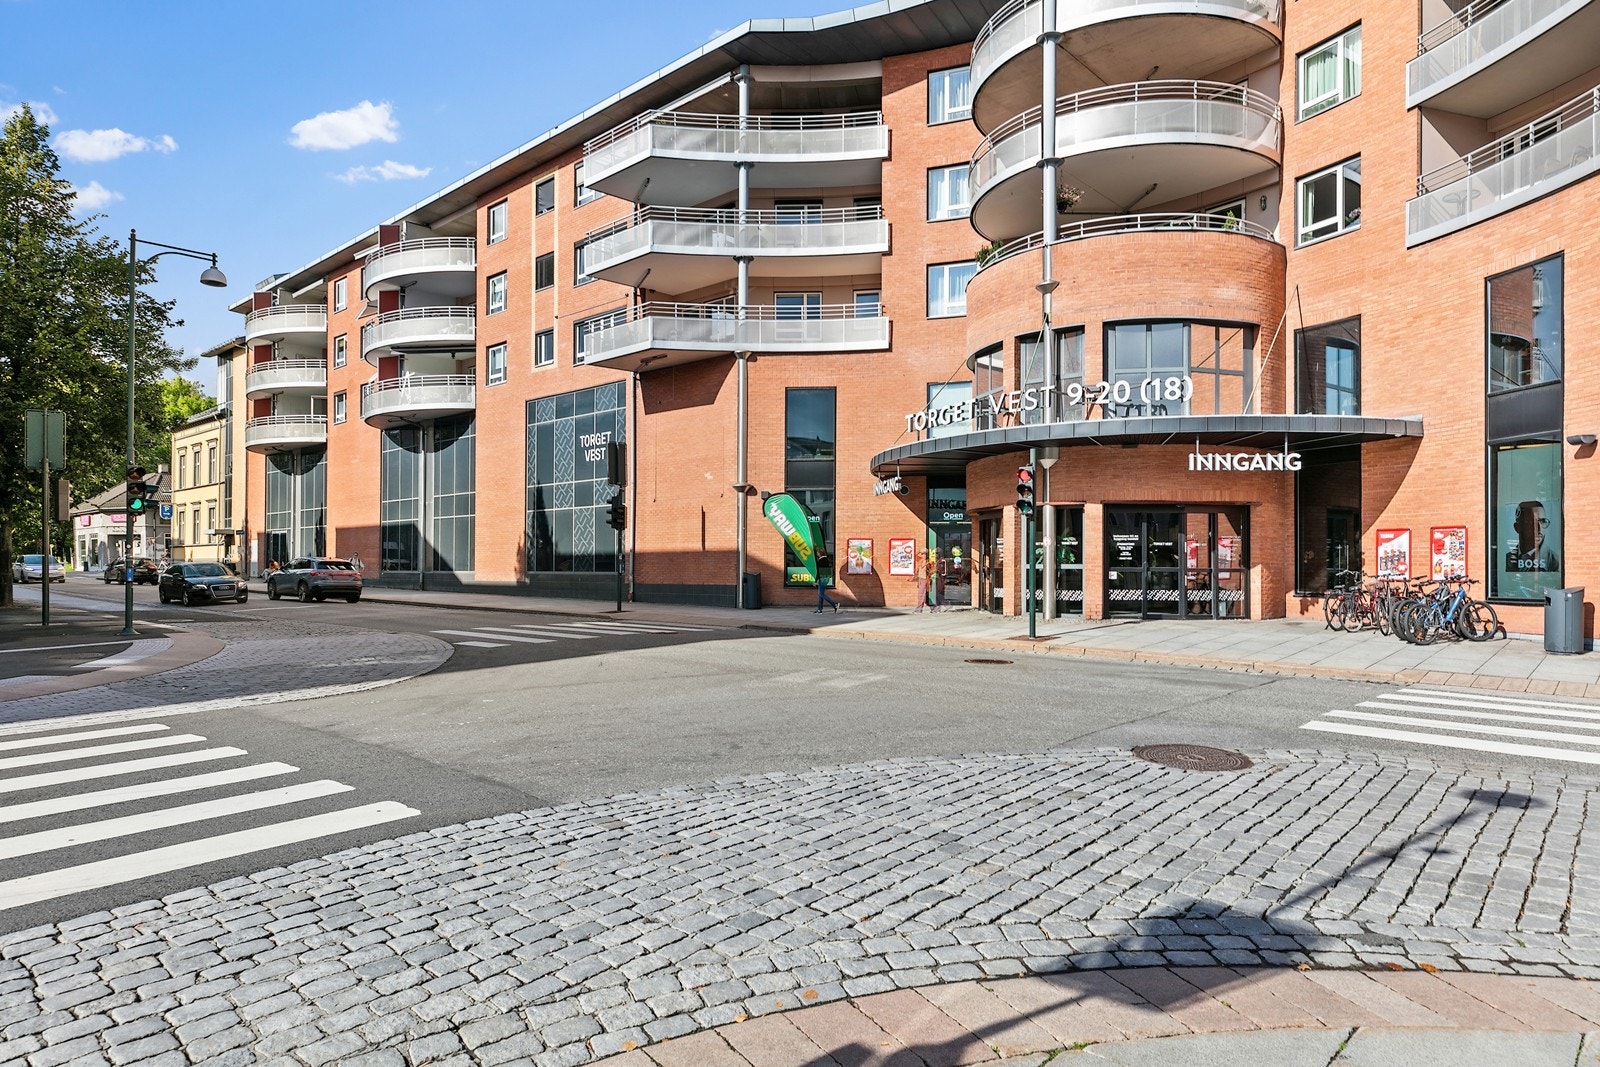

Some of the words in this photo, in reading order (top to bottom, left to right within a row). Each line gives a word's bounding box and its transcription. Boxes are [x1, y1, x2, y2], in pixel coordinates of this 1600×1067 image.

[905, 397, 977, 433] TORGET
[988, 385, 1055, 415] VEST
[1067, 380, 1131, 406] 9-20
[1140, 376, 1194, 404] (18)
[579, 431, 612, 448] TORGET
[584, 447, 606, 462] VEST
[1188, 452, 1302, 471] INNGANG
[943, 511, 964, 520] Open
[1517, 559, 1546, 569] BOSS
